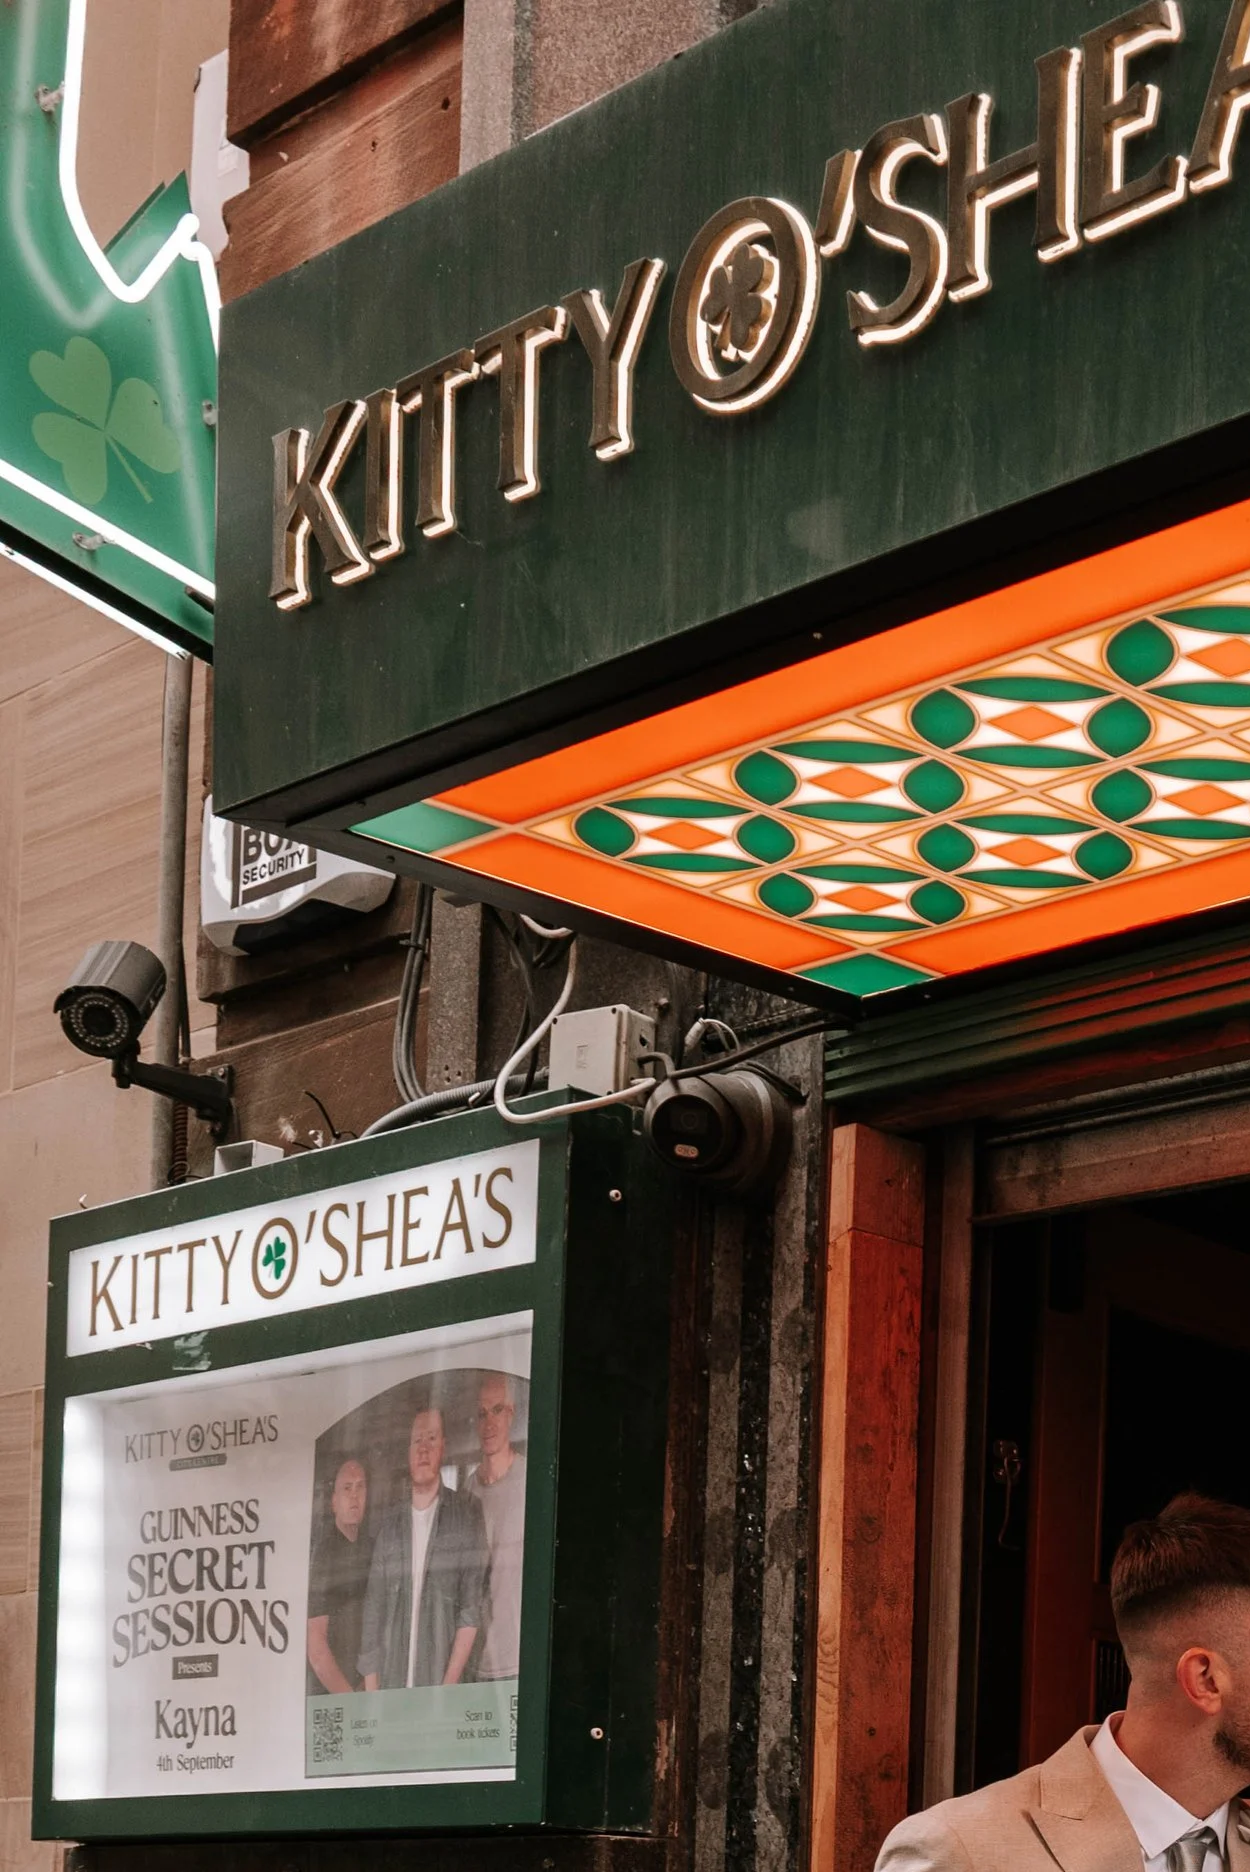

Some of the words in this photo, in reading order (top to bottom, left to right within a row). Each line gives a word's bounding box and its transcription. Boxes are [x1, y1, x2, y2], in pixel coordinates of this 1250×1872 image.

[271, 257, 665, 609] KITTY
[242, 849, 305, 885] SECURITY
[243, 827, 298, 866] BO
[88, 1229, 243, 1337] KITTY
[251, 1167, 514, 1300] O'SHEA'S
[125, 1428, 182, 1463] KITTY
[187, 1415, 278, 1453] O'SHEA'S
[140, 1498, 260, 1544] GUINNESS
[127, 1540, 275, 1603] SECRET
[113, 1598, 289, 1668] SESSIONS
[177, 1661, 213, 1675] Presents
[155, 1699, 237, 1749] Kayna
[456, 1728, 476, 1740] book
[478, 1725, 500, 1739] tickets
[465, 1710, 482, 1722] Scan
[156, 1755, 173, 1772] 4th
[177, 1752, 235, 1773] September
